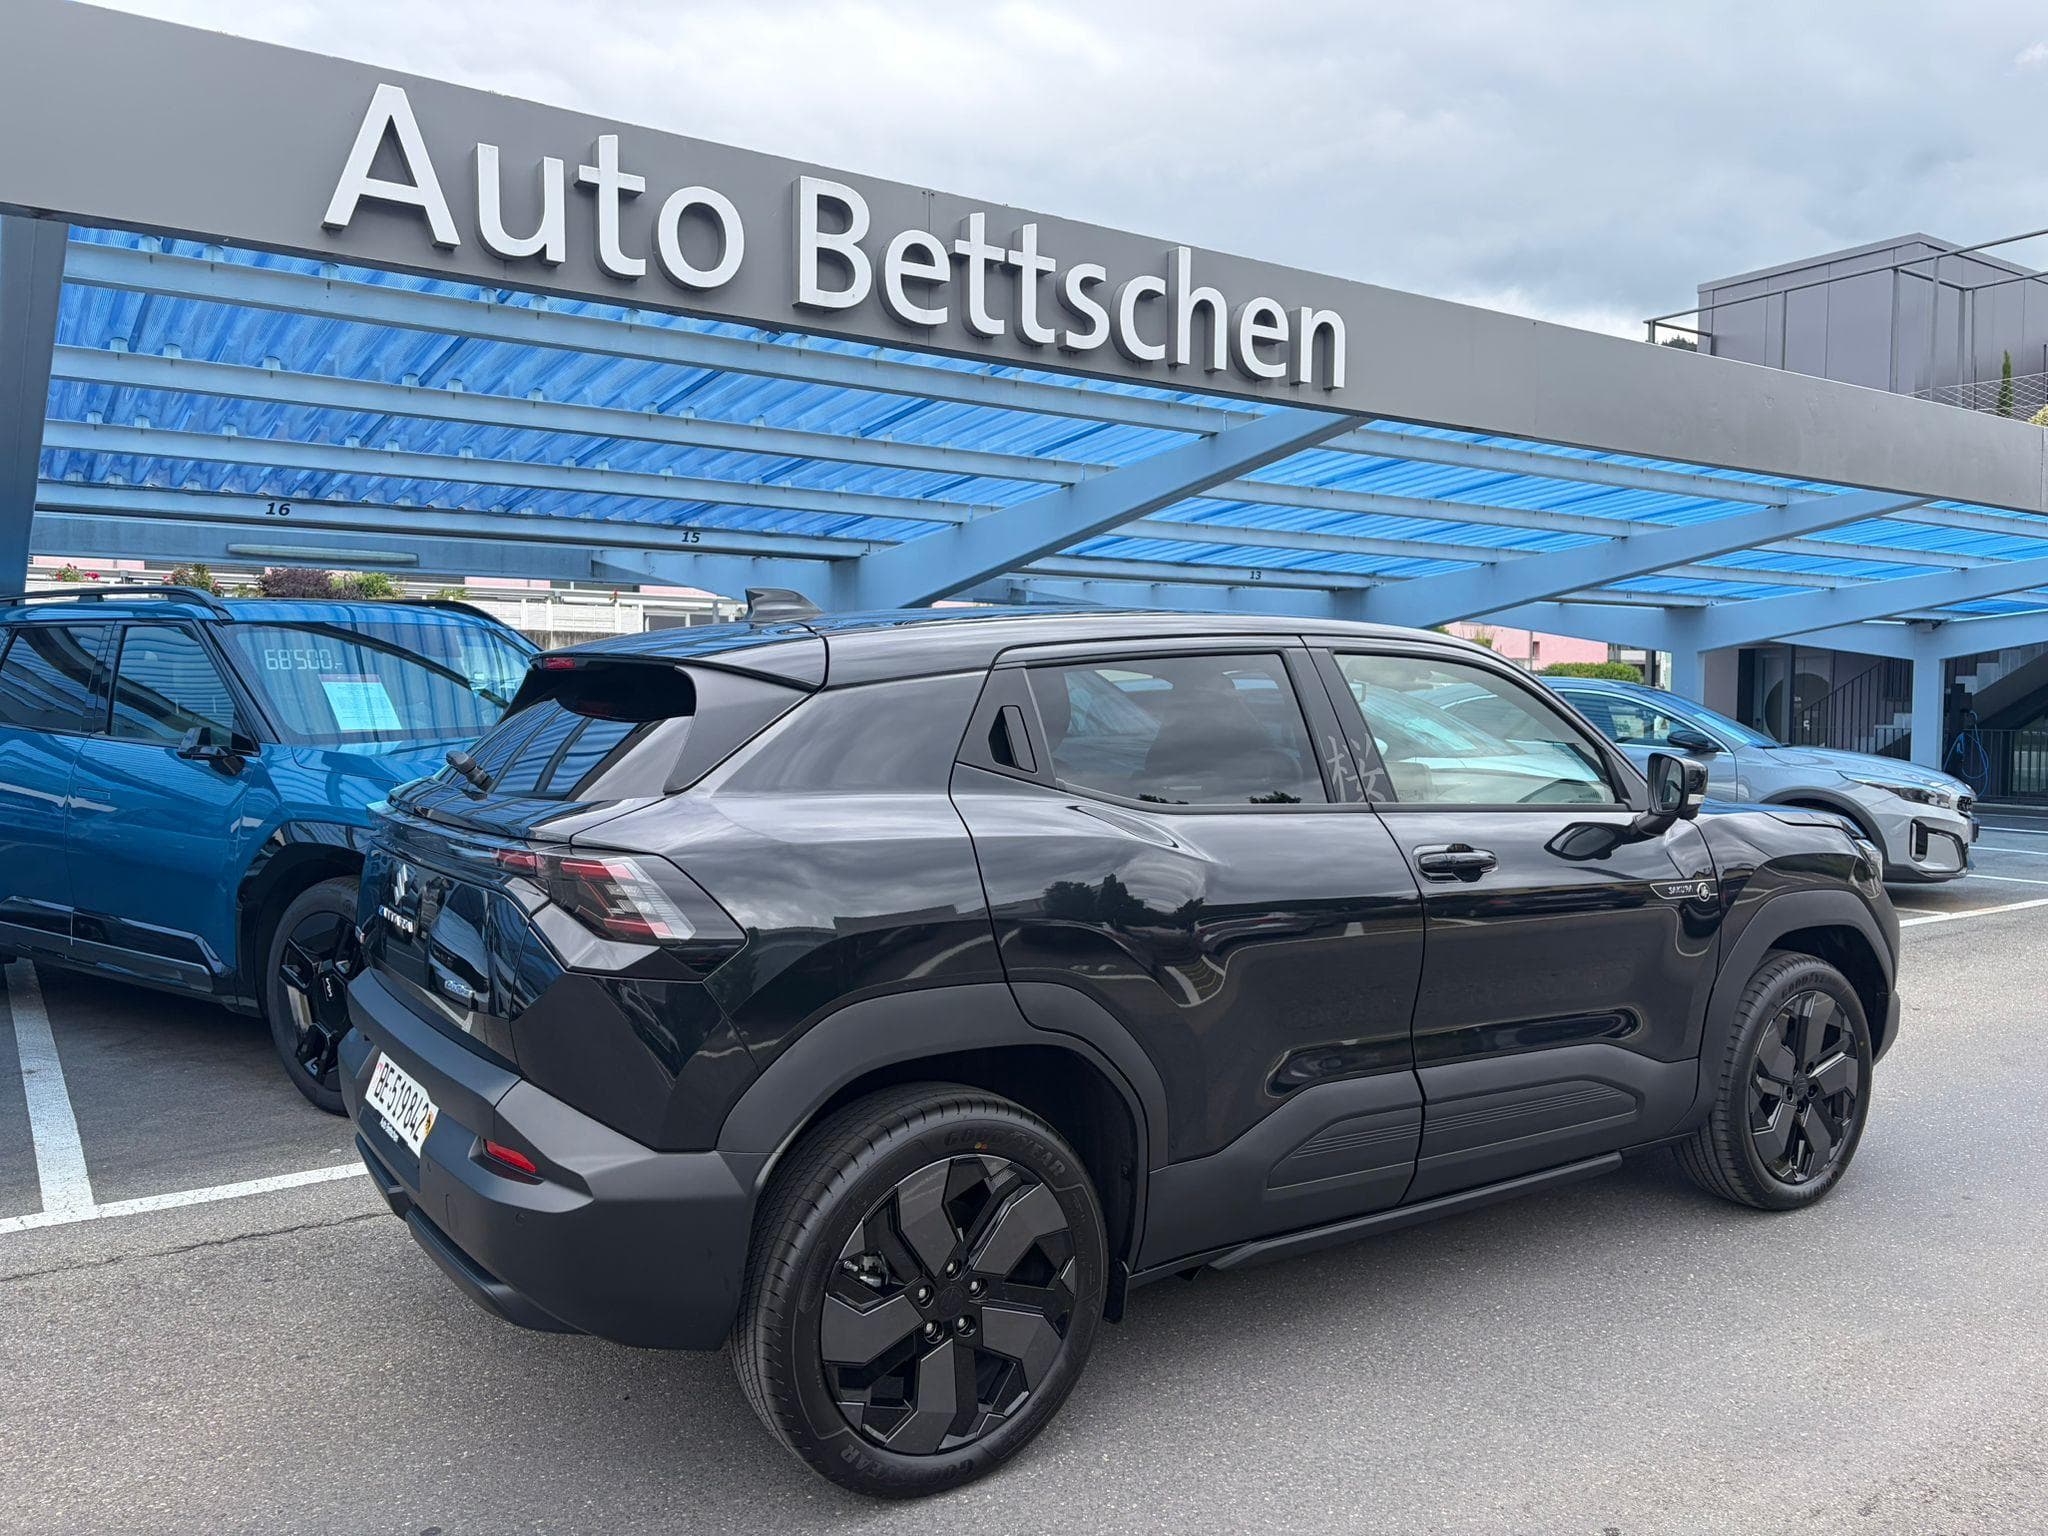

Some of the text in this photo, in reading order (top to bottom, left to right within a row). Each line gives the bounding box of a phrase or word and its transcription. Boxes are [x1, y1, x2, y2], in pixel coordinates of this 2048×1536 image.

[323, 83, 1346, 390] Auto Bettschen
[265, 502, 291, 516] 16
[682, 531, 701, 543] 15
[1250, 570, 1262, 580] 13
